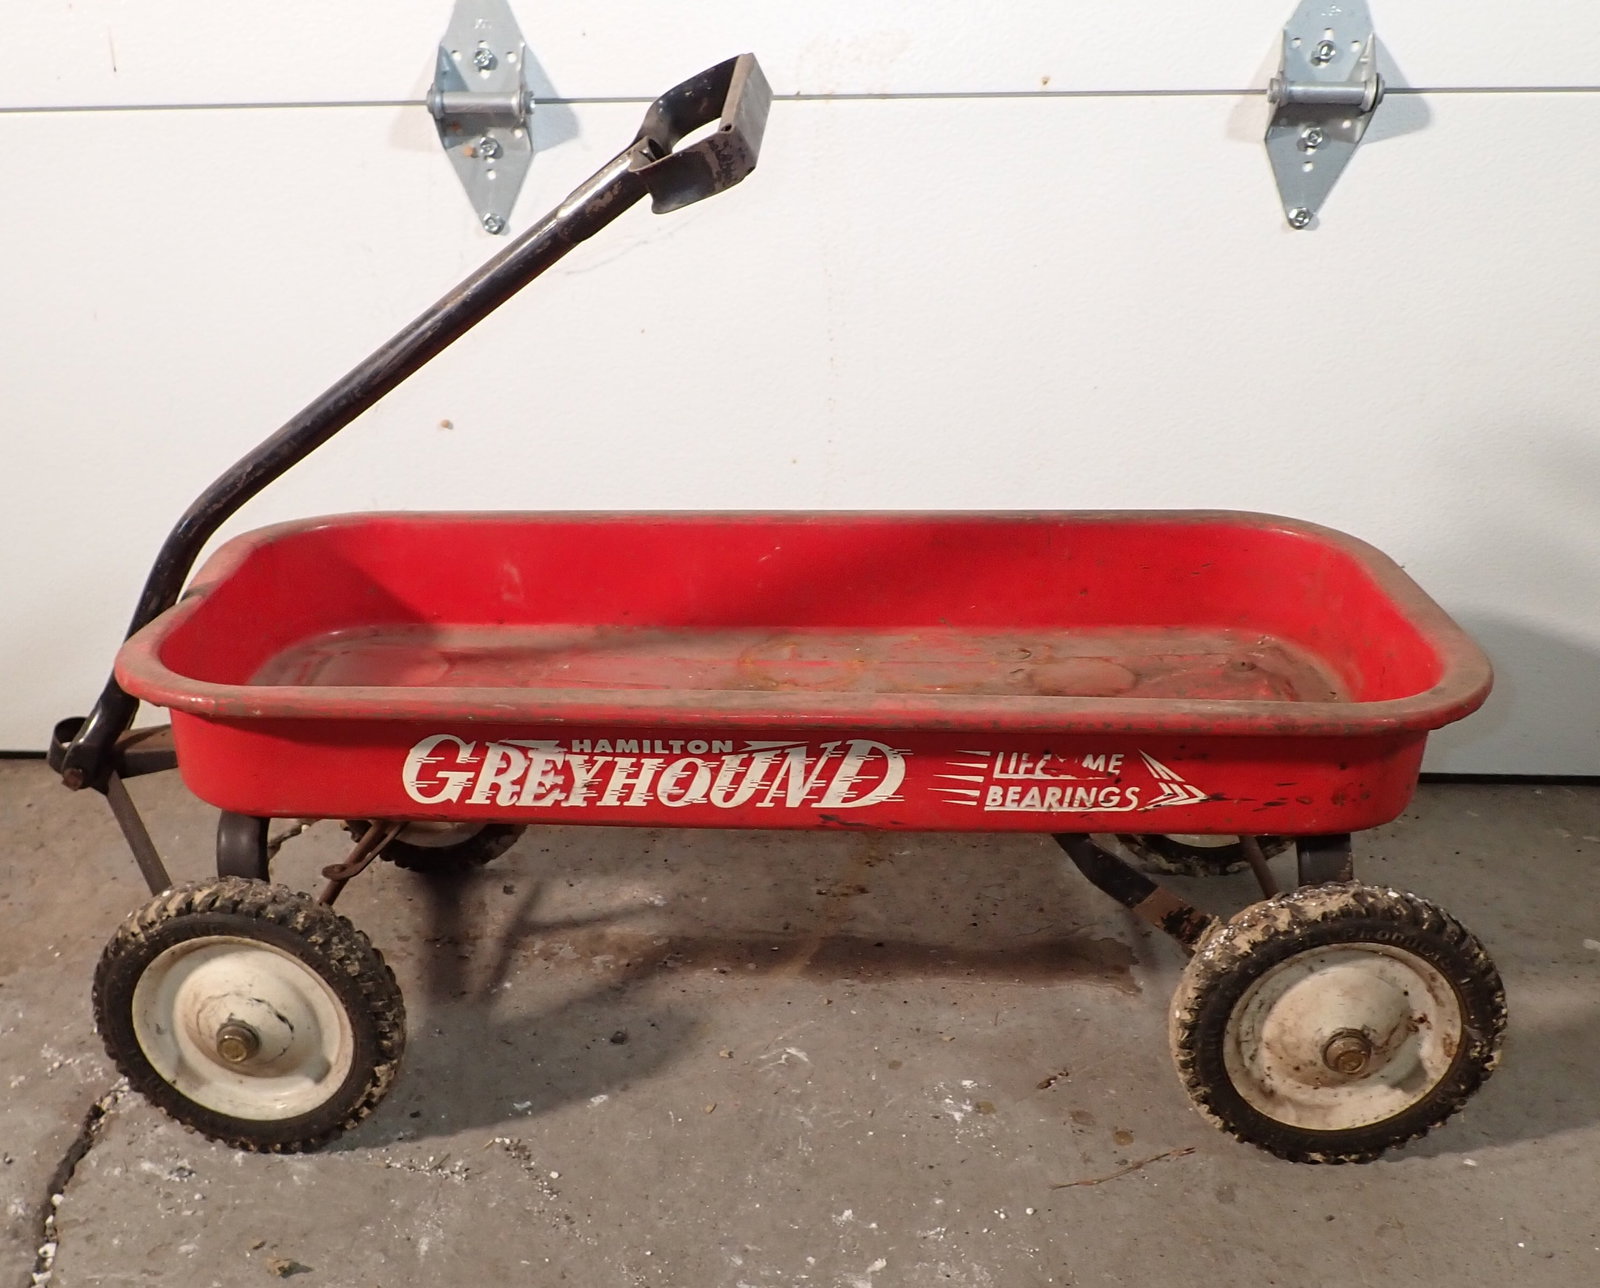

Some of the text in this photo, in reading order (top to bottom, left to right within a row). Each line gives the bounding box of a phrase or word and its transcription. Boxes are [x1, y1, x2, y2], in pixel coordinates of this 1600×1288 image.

[571, 739, 734, 754] HAMILTON
[402, 734, 908, 809] GREYHOUND
[984, 785, 1141, 812] BEARINGS
